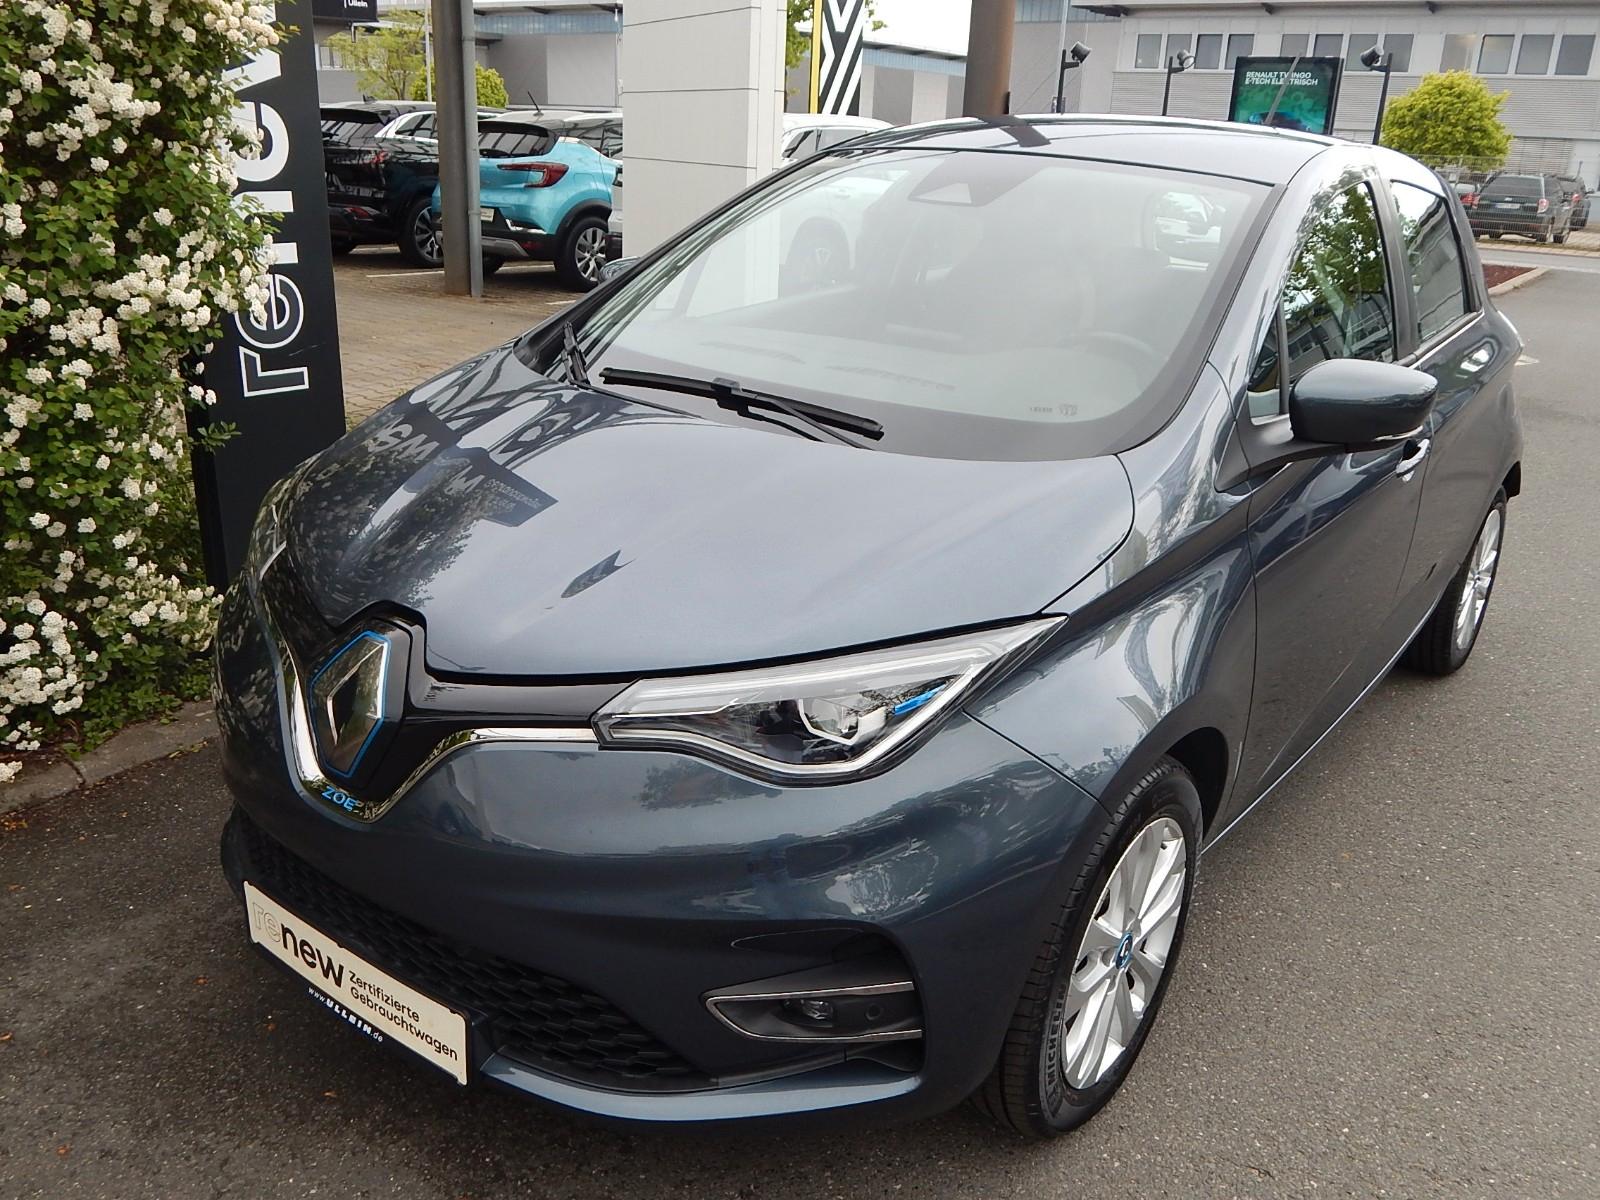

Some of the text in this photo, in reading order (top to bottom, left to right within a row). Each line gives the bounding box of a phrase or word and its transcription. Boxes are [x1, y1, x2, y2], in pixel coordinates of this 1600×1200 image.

[1271, 78, 1318, 86] ELETRISCH
[322, 785, 356, 812] ZOE
[252, 902, 344, 988] renew
[349, 970, 420, 1022] Zertifizierte
[350, 986, 458, 1061] Gebrauchtwagen
